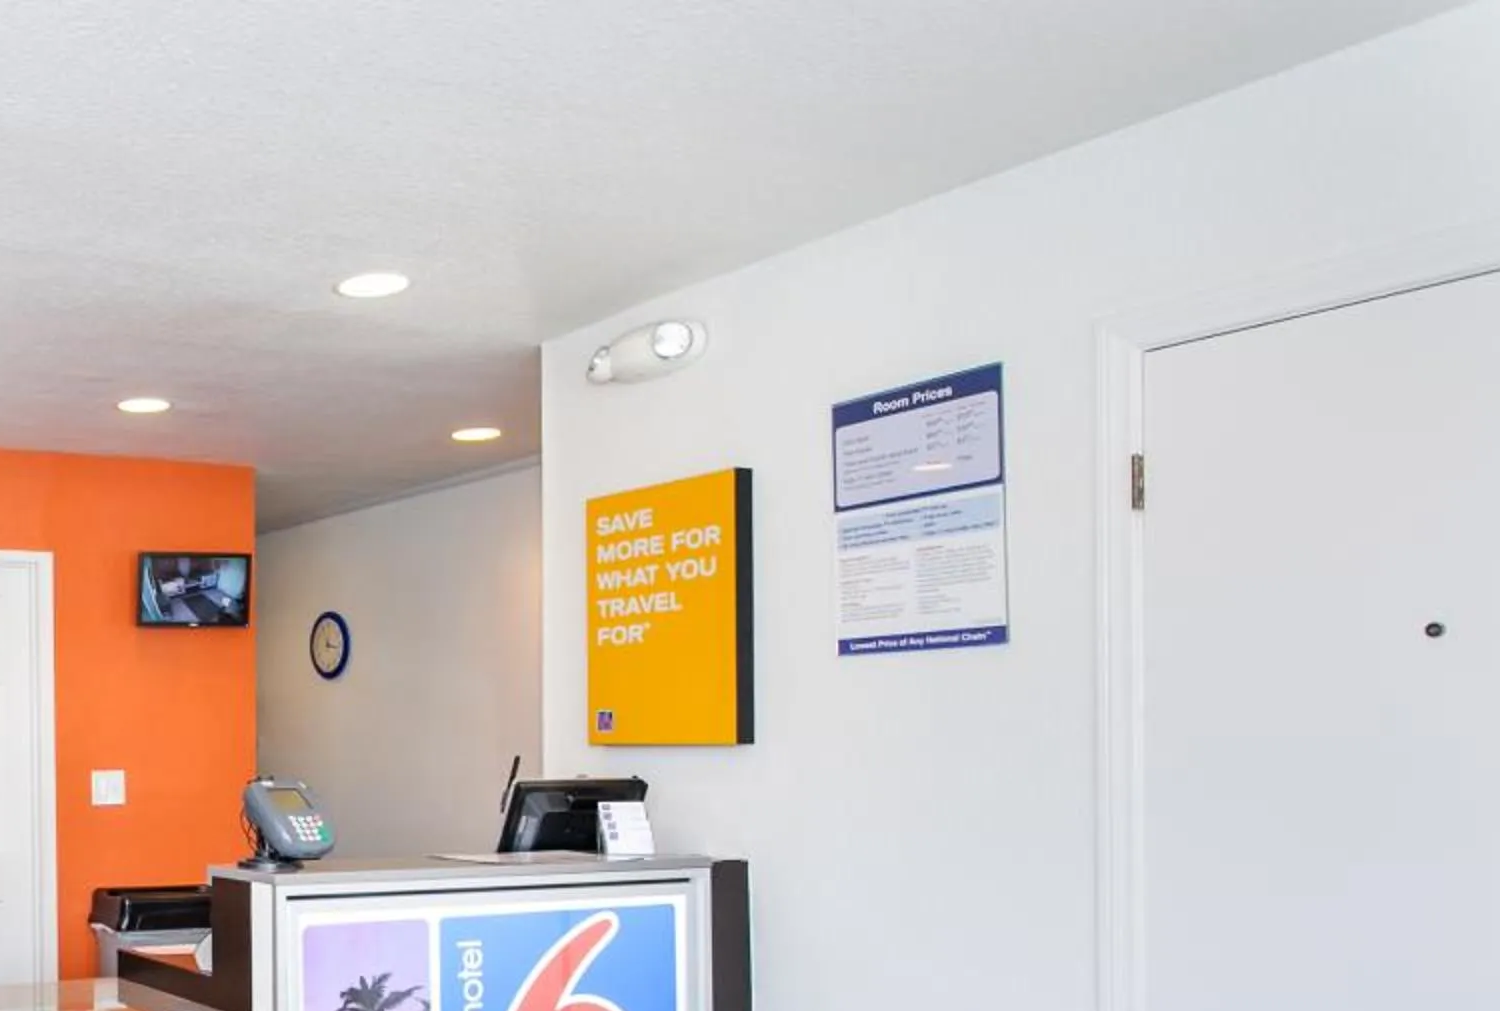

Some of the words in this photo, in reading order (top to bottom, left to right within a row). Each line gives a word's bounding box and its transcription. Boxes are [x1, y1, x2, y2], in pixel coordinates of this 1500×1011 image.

[873, 396, 909, 415] Room
[912, 386, 953, 405] Prices
[596, 508, 653, 536] SAVE
[596, 535, 665, 564] MORE
[671, 525, 721, 551] FOR
[596, 565, 660, 590] WHAT
[665, 556, 718, 582] YOU
[596, 591, 682, 618] TRAVEL
[909, 635, 925, 647] Any
